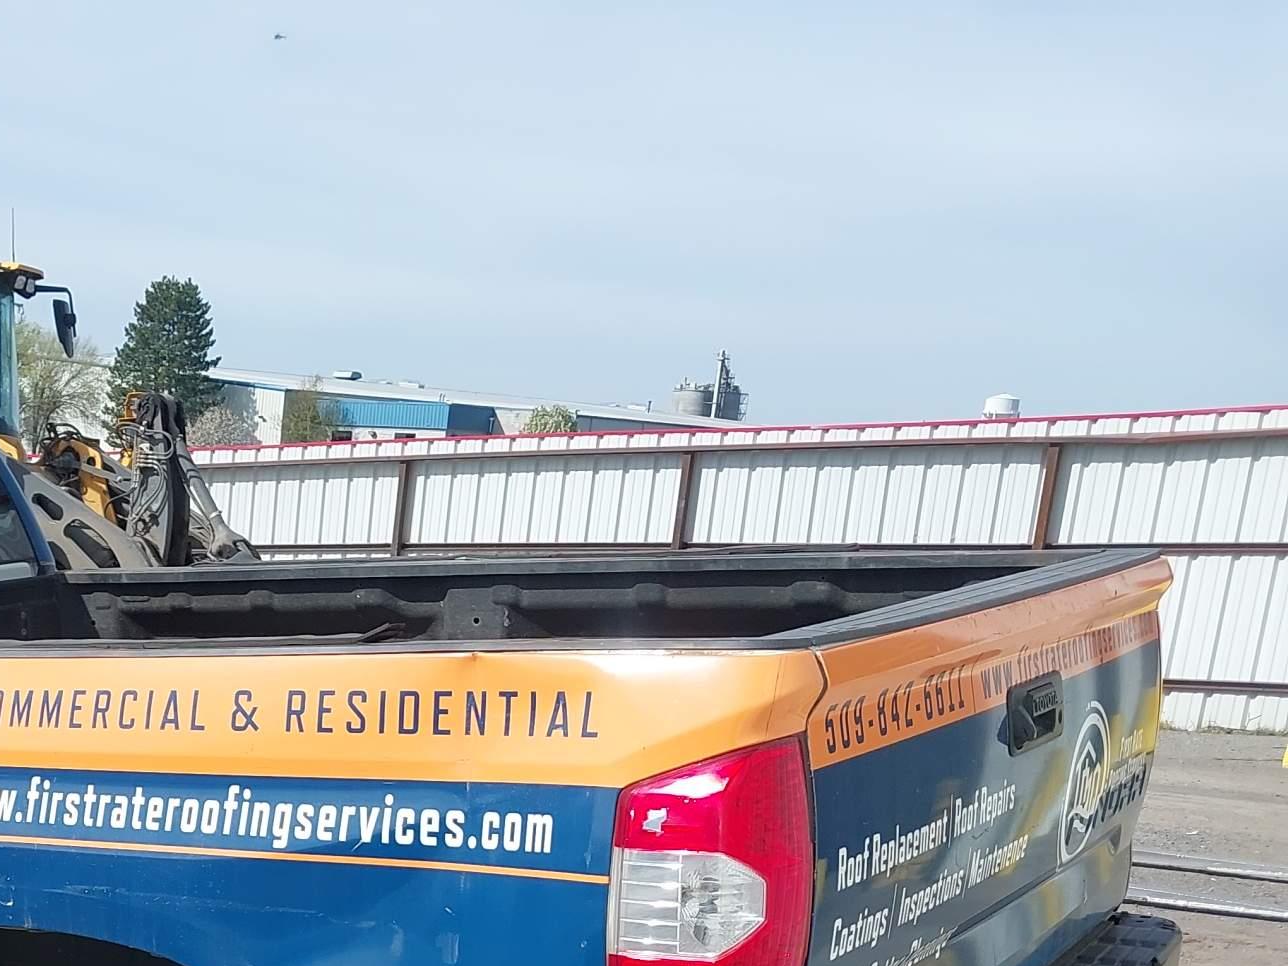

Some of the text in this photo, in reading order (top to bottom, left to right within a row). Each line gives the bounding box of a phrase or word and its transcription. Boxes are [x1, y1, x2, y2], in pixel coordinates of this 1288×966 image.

[232, 690, 259, 731] &
[286, 691, 597, 737] RESIDENTIAL
[825, 666, 965, 754] 509-842-6611
[838, 779, 1015, 891] Roof Replacement Roof Repairs
[830, 834, 1029, 962] Coatings Inspections Maintenence
